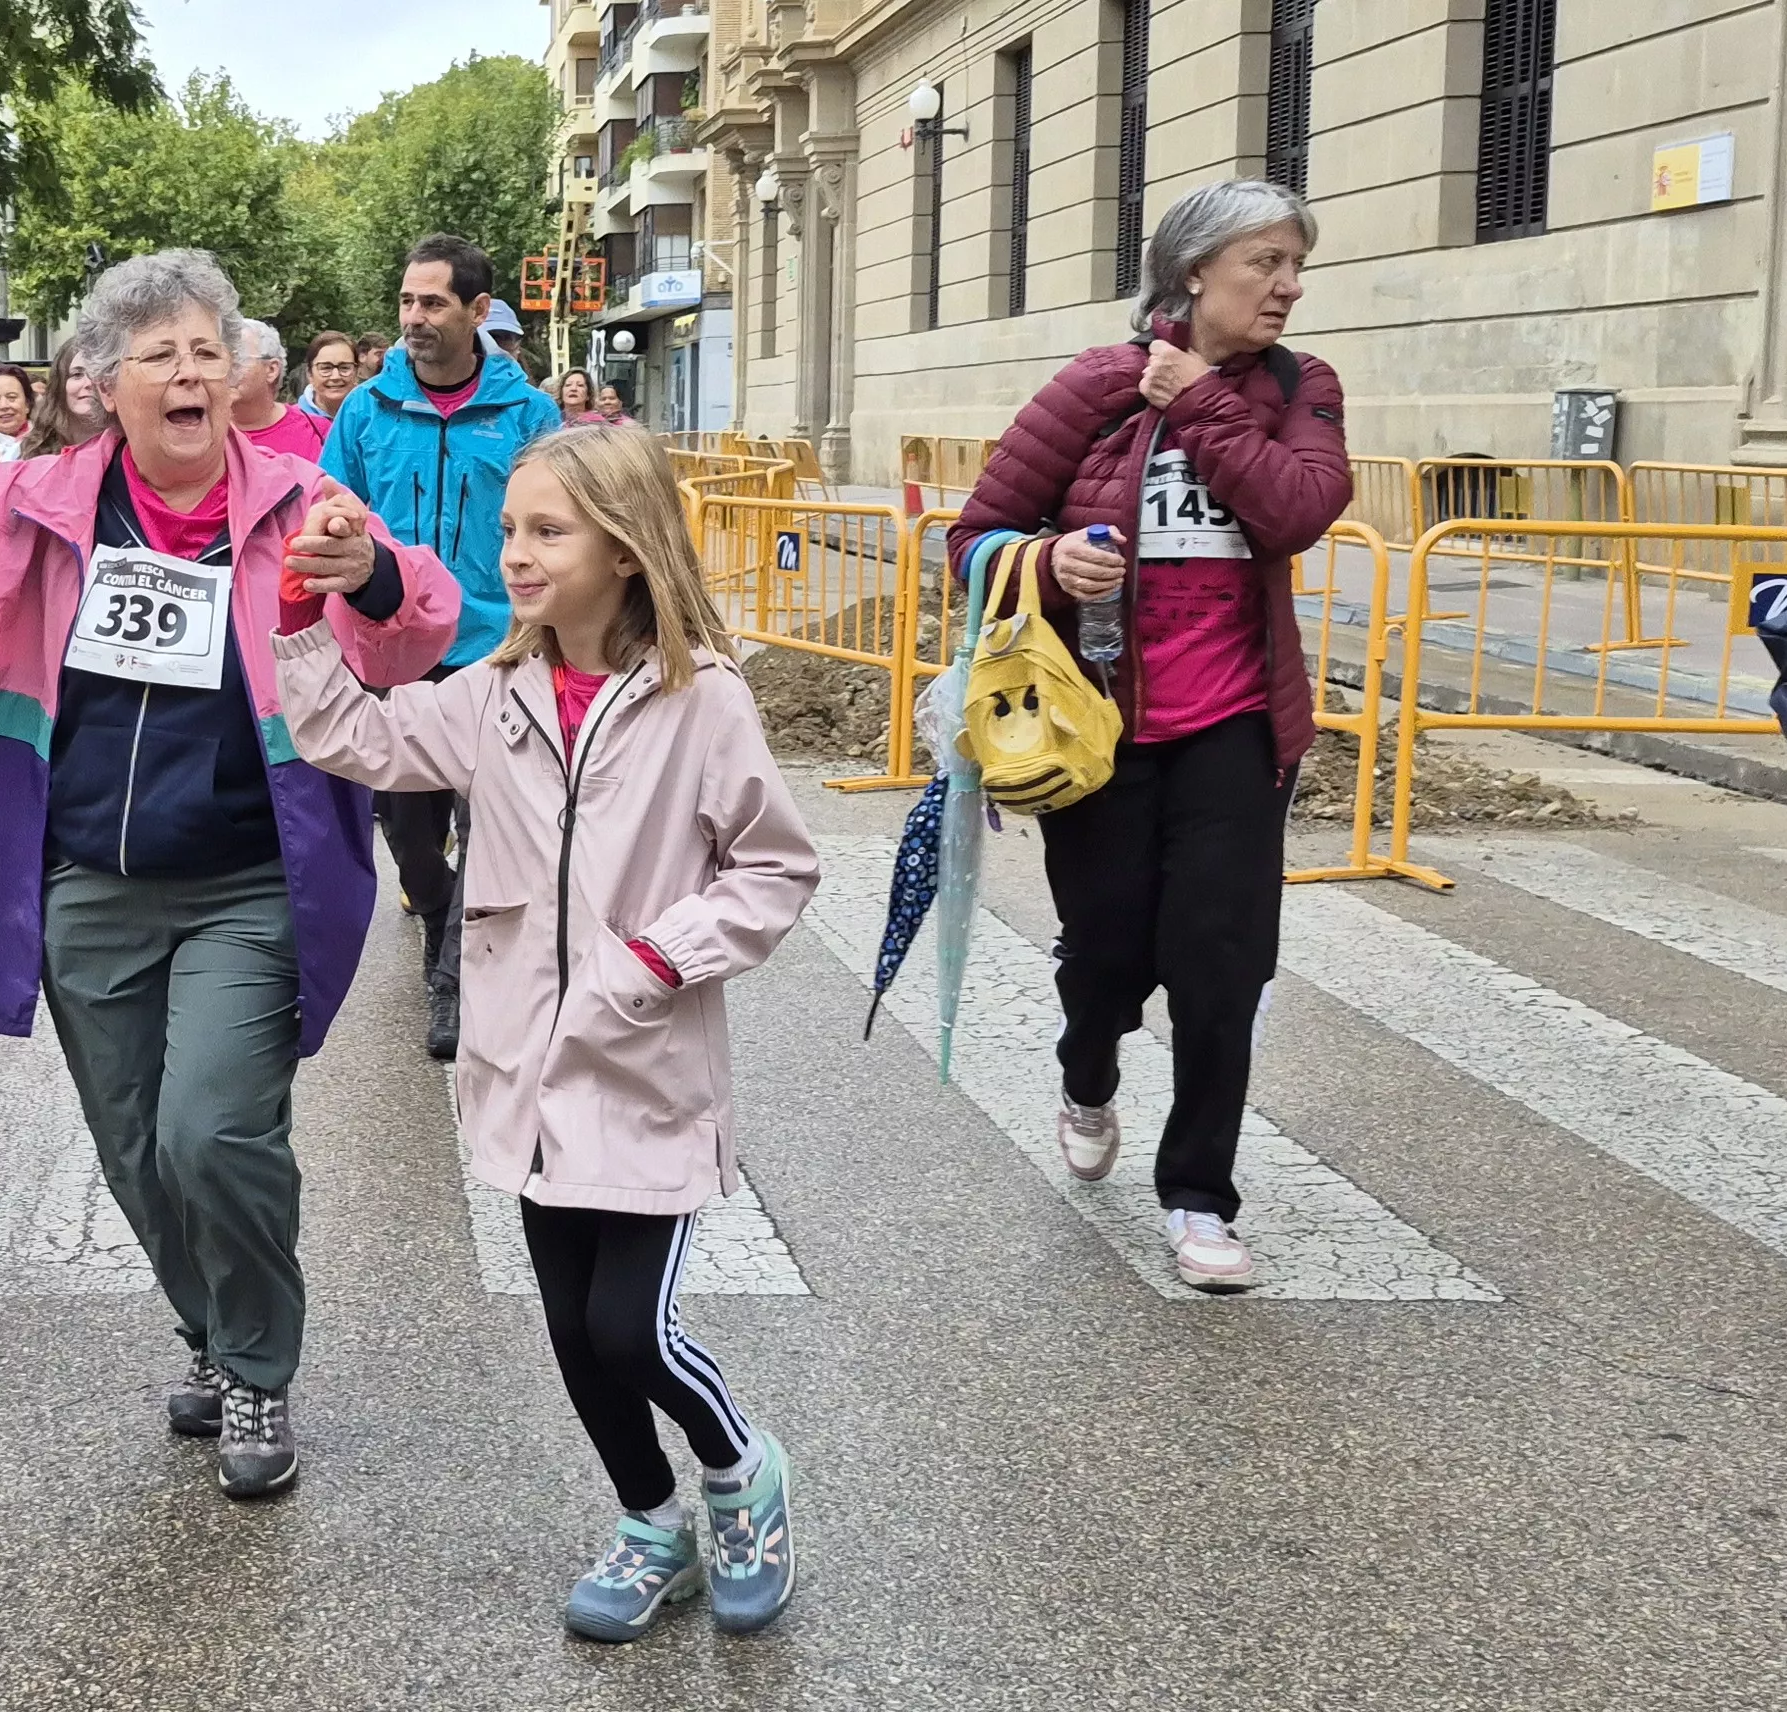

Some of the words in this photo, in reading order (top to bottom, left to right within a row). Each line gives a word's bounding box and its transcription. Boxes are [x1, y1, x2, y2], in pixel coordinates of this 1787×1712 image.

[1145, 489, 1235, 527] 145
[138, 575, 153, 588] EL
[156, 579, 207, 600] CÁNCER
[94, 593, 188, 648] 339
